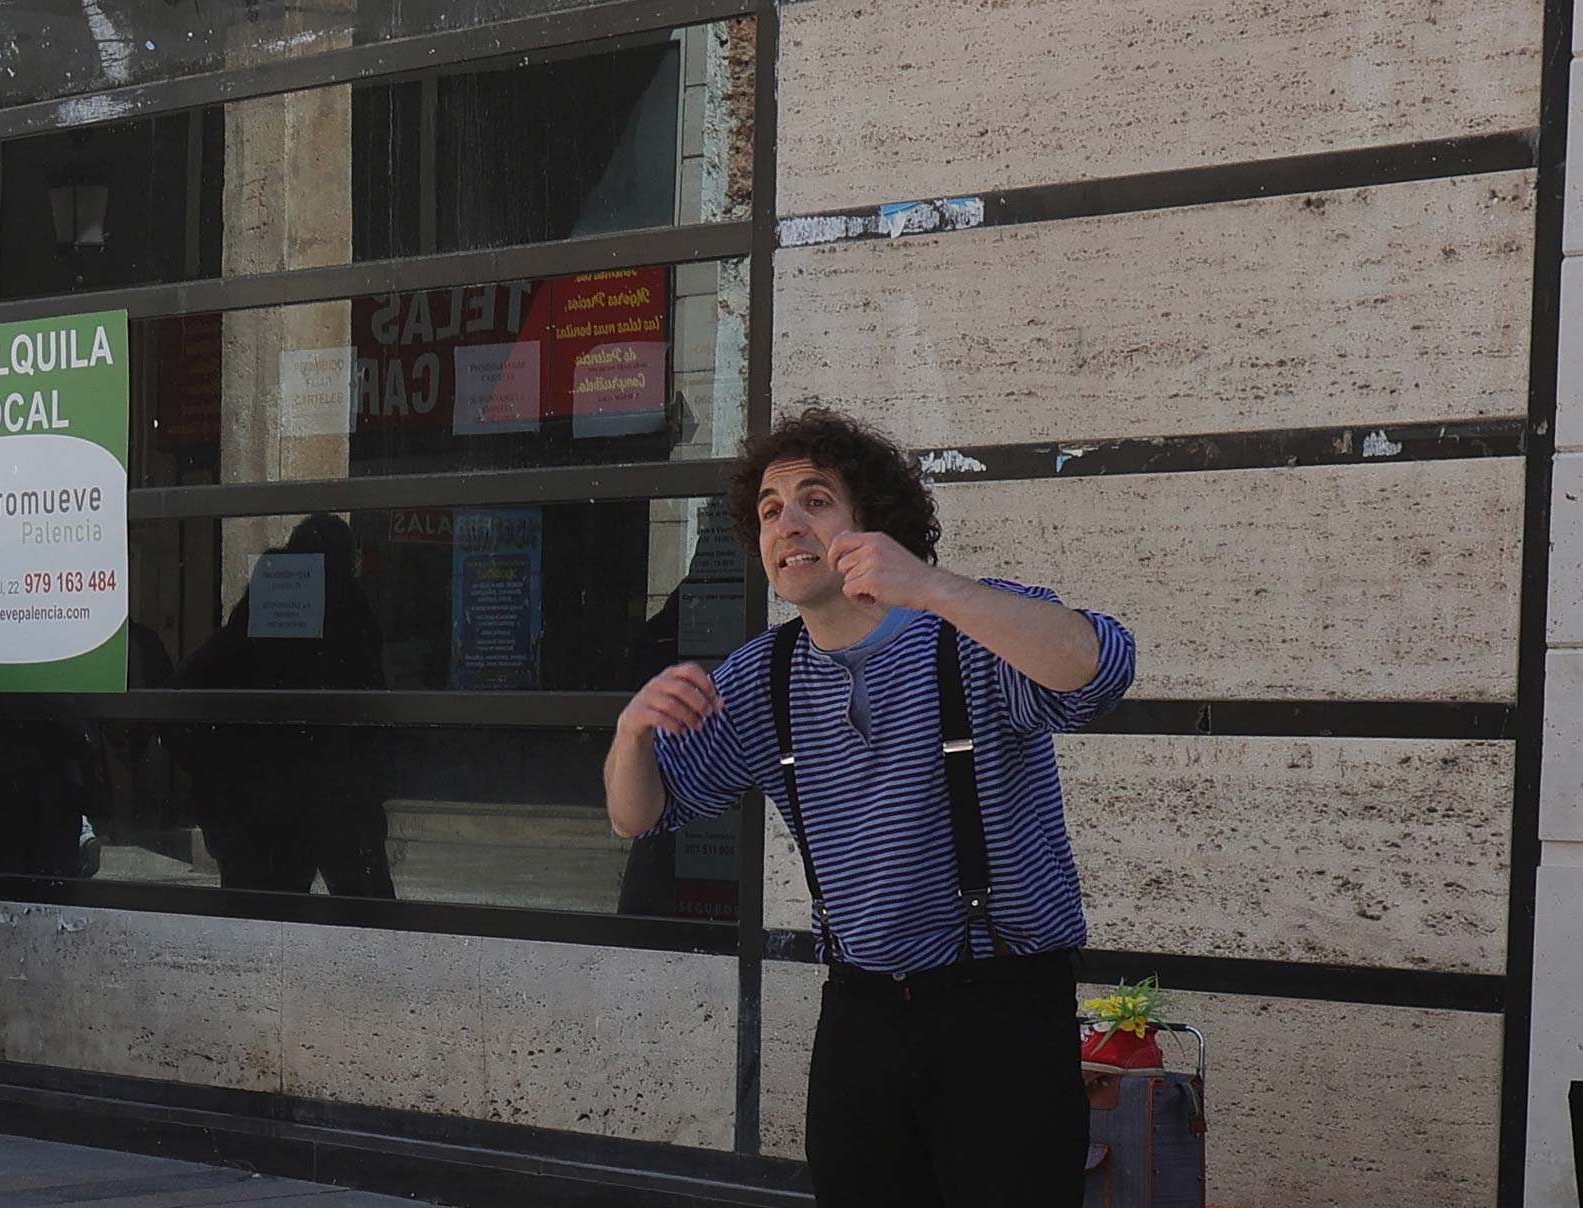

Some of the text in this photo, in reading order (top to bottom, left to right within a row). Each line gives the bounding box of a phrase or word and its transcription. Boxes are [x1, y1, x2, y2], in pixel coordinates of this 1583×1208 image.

[21, 519, 103, 545] Palencia
[8, 580, 20, 596] 22
[24, 571, 51, 594] 979
[56, 570, 84, 594] 163
[88, 569, 117, 592] 484
